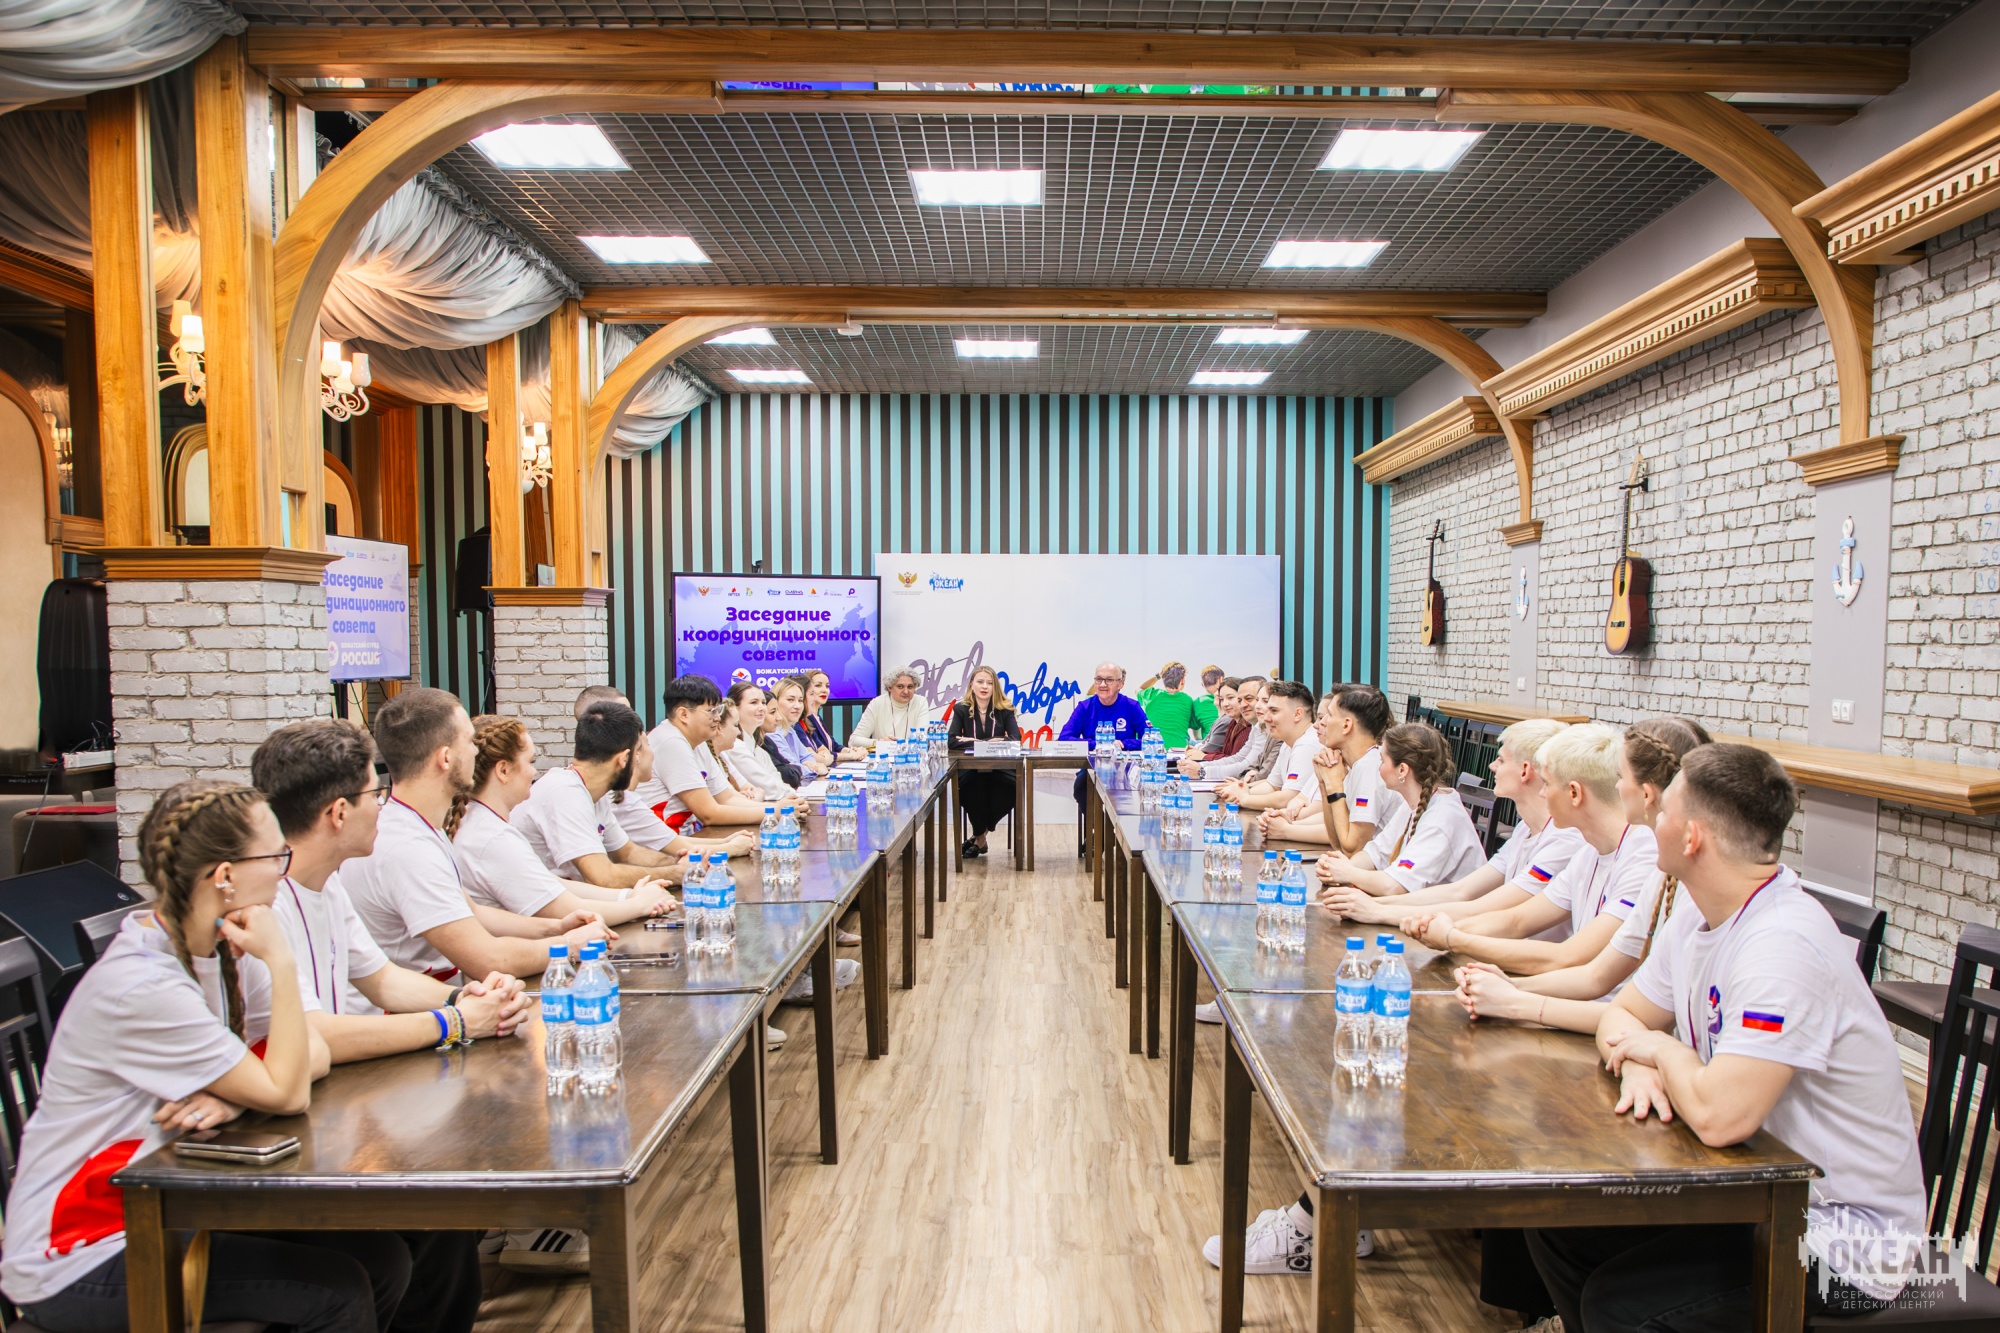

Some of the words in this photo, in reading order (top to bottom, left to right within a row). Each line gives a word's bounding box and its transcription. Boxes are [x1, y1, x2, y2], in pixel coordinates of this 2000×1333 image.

[322, 568, 384, 592] Заседание
[934, 579, 959, 589] ОКЕАН
[326, 595, 406, 614] динационного
[725, 606, 832, 625] Заседание
[332, 619, 376, 634] совета
[683, 628, 871, 645] координационного
[341, 651, 380, 666] РОССИЯ
[742, 648, 816, 662] совета
